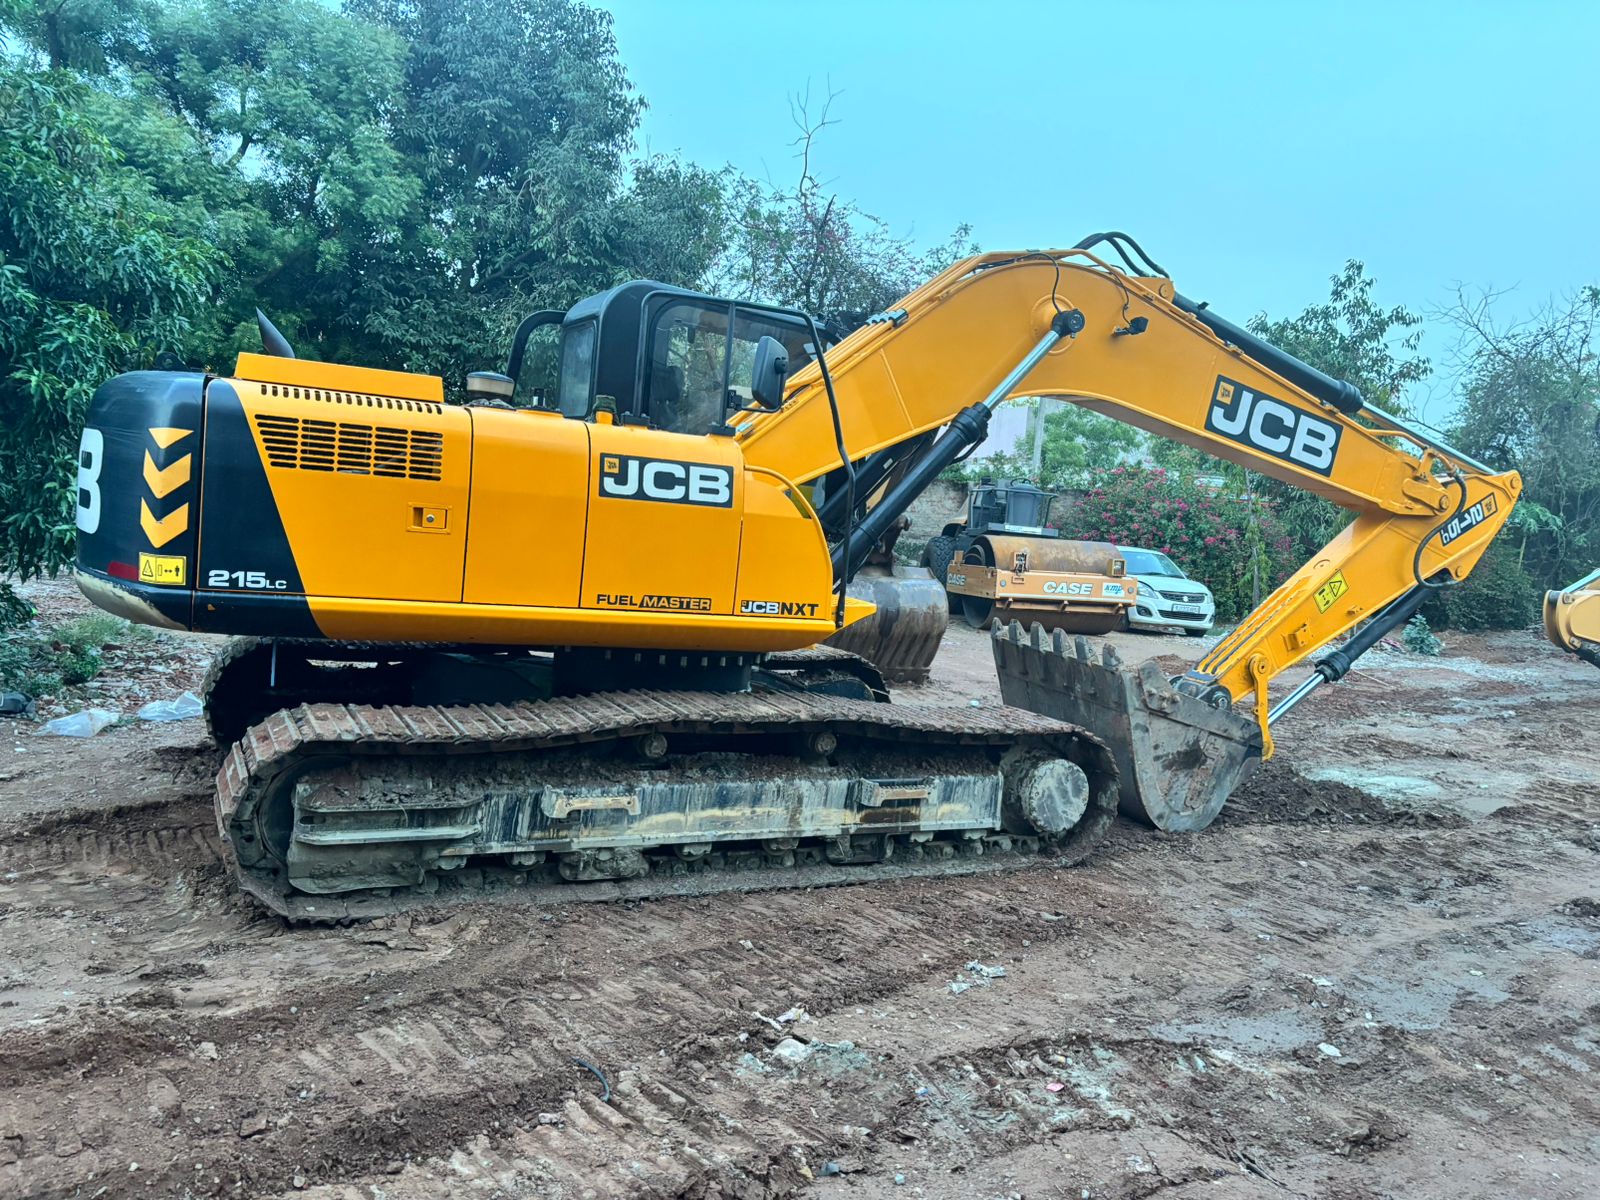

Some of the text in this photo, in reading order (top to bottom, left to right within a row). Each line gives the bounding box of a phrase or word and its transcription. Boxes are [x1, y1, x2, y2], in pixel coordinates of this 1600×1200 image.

[1211, 389, 1337, 470] JCB
[603, 459, 730, 504] JCB
[596, 594, 711, 610] FUEL MASTER
[1043, 581, 1093, 595] CASE
